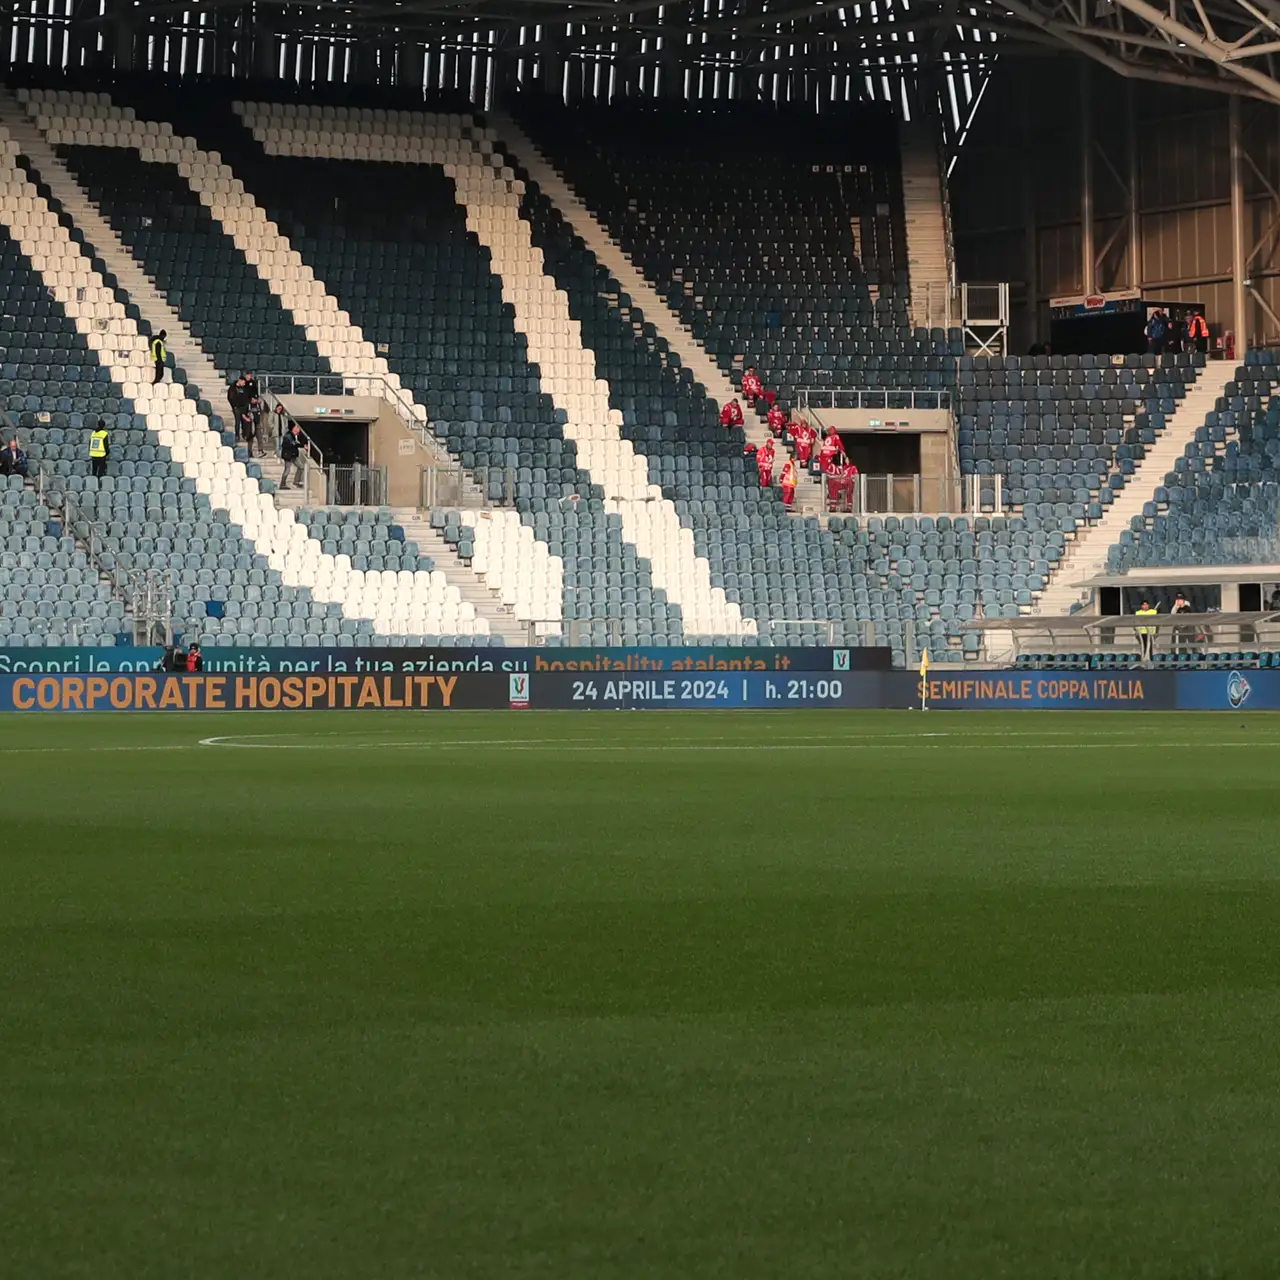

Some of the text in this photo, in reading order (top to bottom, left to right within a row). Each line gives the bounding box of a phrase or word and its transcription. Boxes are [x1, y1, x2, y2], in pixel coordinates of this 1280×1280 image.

[12, 675, 458, 710] CORPORATE HOSPITALITY
[572, 680, 598, 700] 24
[604, 680, 675, 700] APRILE
[680, 680, 729, 700] 2024
[765, 680, 782, 700] h.
[787, 680, 843, 700] 21:00
[918, 680, 1144, 700] SEMIFINALE COPPA ITALIA
